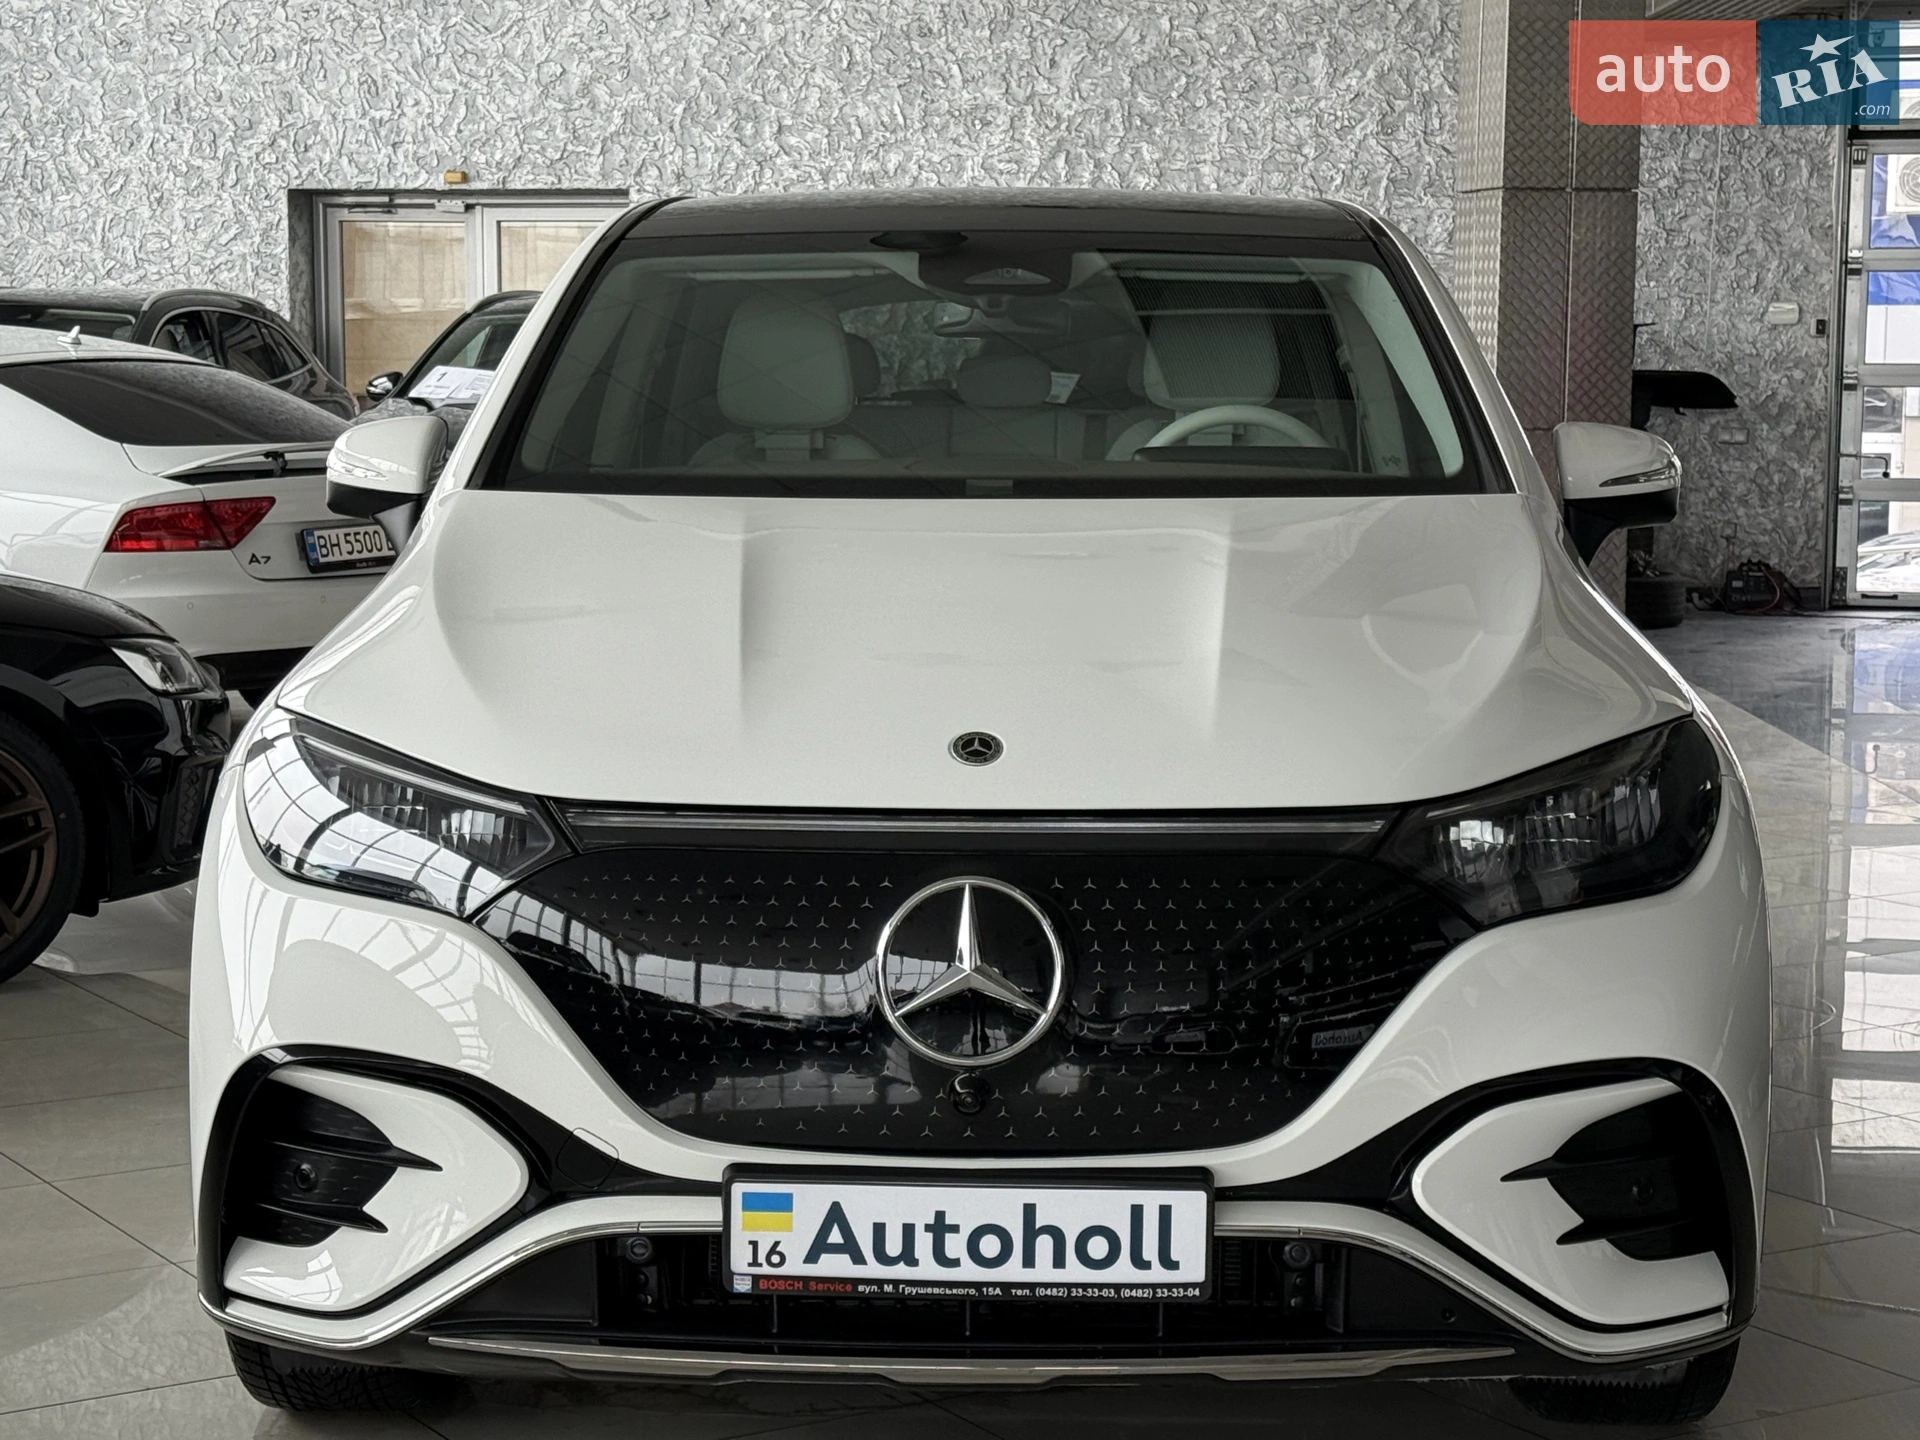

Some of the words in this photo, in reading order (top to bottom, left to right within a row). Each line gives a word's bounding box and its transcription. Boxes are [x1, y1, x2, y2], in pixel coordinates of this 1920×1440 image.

[317, 534, 343, 558] BH
[344, 530, 383, 555] 5500
[248, 552, 271, 565] A7
[802, 1201, 1180, 1270] Autoholl
[747, 1240, 787, 1268] 16
[759, 1279, 803, 1291] BOSCH
[809, 1281, 853, 1292] Service
[858, 1284, 881, 1293] вул.
[884, 1284, 896, 1293] М.
[899, 1284, 979, 1296] Грушевського,
[981, 1287, 1002, 1296] 15А
[1011, 1288, 1033, 1296] тел.
[1035, 1287, 1068, 1298] (0482)
[1070, 1288, 1118, 1299] 33-33-03,
[1120, 1288, 1153, 1299] (0482)
[1155, 1288, 1200, 1298] 33-33-04
